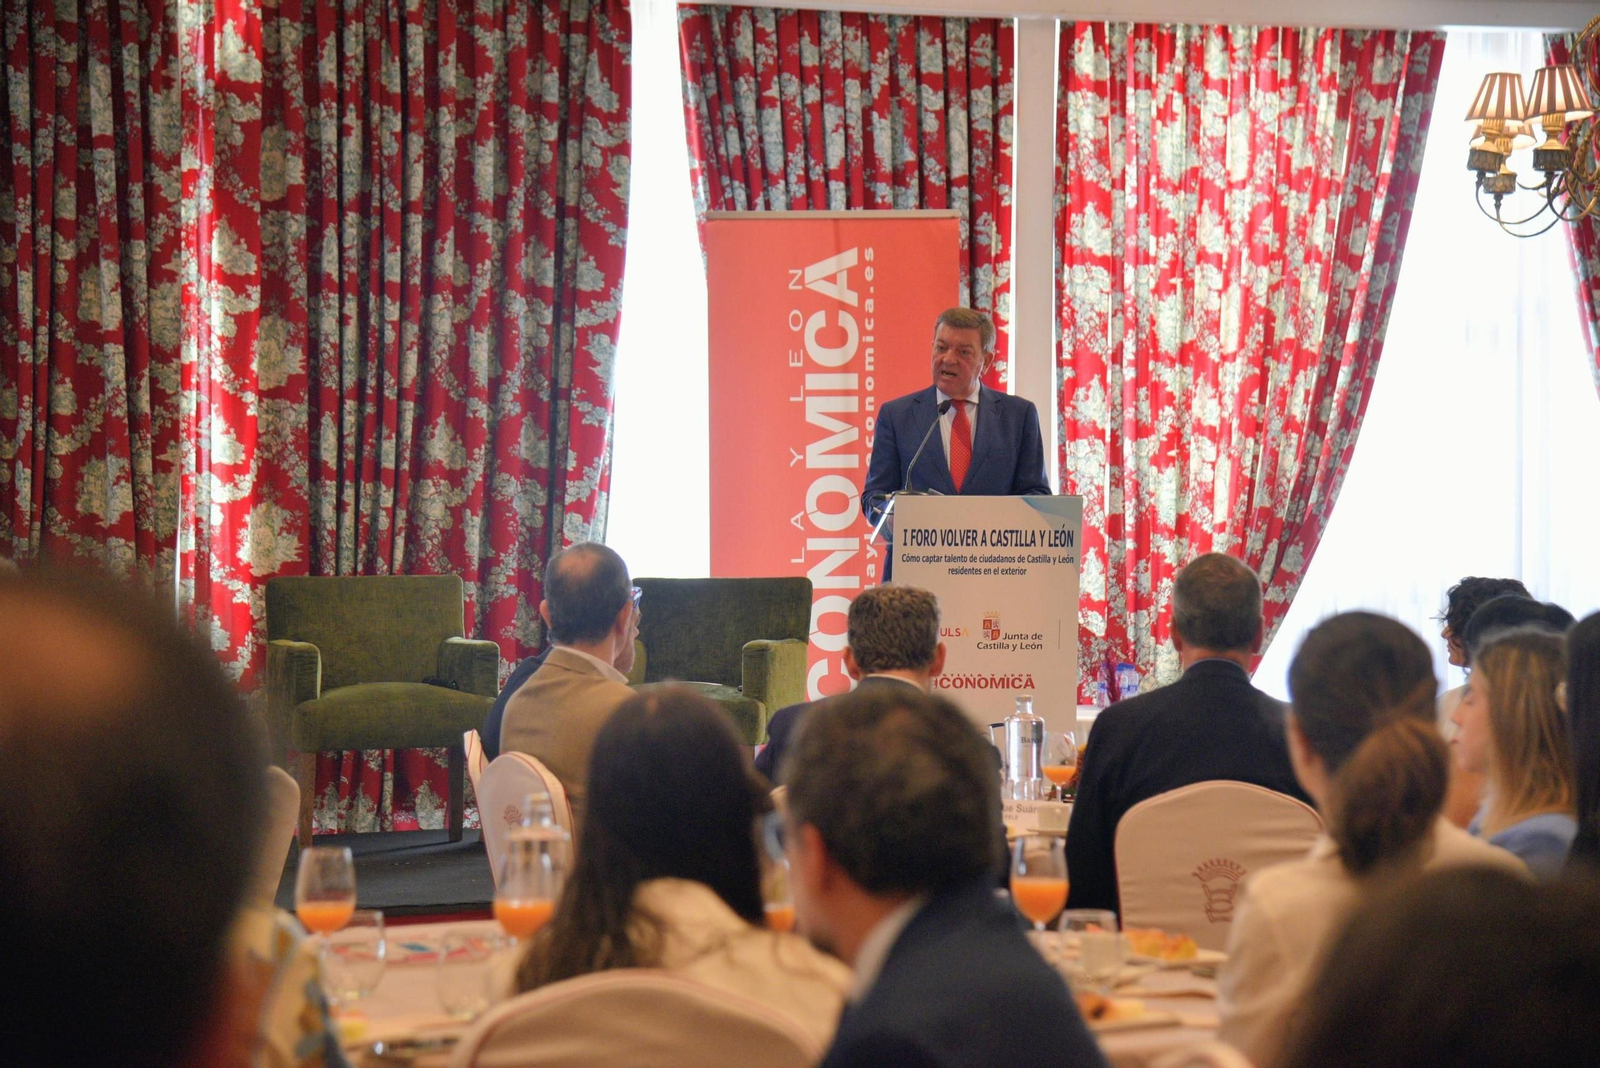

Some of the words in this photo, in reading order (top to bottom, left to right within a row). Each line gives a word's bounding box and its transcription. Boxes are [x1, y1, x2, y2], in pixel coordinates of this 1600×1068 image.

[788, 268, 804, 403] LEON
[789, 446, 805, 467] Y
[804, 246, 860, 702] CONOMICA
[789, 509, 805, 564] LA
[902, 529, 909, 547] I
[910, 529, 938, 547] FORO
[940, 529, 979, 547] VOLVER
[980, 529, 988, 547] A
[989, 529, 1037, 547] CASTILLA
[1039, 529, 1047, 547] Y
[1048, 524, 1075, 548] LEÓN
[901, 553, 921, 563] Cómo
[922, 554, 943, 566] captar
[944, 553, 967, 563] talento
[969, 553, 978, 563] de
[979, 553, 1016, 564] ciudadanos
[1017, 554, 1026, 563] de
[1027, 554, 1052, 564] Castilla
[1053, 556, 1057, 566] y
[1058, 554, 1075, 564] León
[948, 566, 982, 575] residentes
[993, 566, 1000, 575] el
[1001, 566, 1027, 576] exterior
[940, 627, 969, 637] ULSA
[1002, 632, 1029, 640] Junta
[1031, 632, 1043, 640] de
[976, 641, 1010, 650] Castilla
[1012, 644, 1018, 652] y
[1020, 641, 1043, 650] León
[933, 677, 1036, 690] CONOMICA
[1015, 803, 1036, 813] Suár
